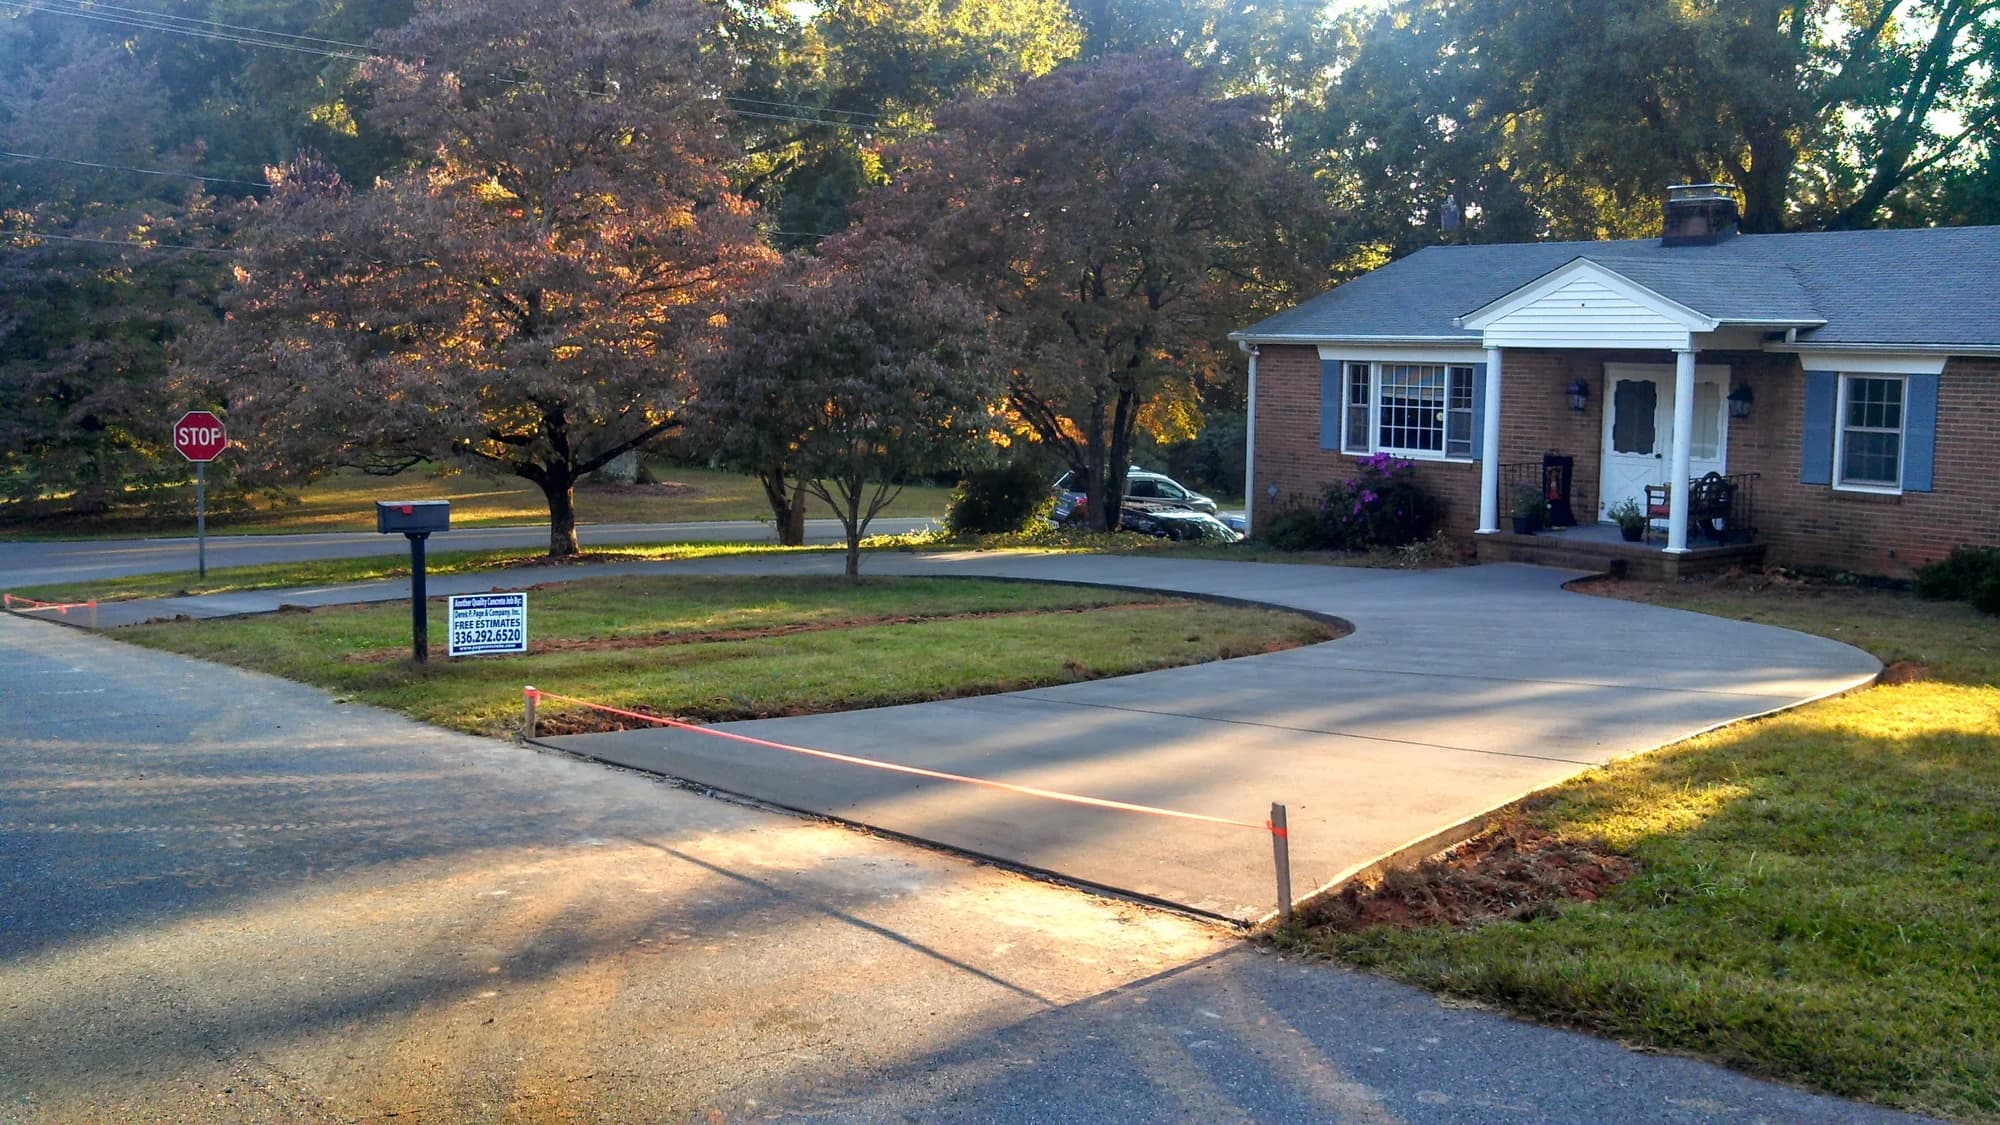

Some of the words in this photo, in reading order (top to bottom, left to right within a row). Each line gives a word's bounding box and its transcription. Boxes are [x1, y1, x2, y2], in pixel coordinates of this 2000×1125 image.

[178, 427, 221, 446] STOP
[454, 598, 472, 608] Another
[472, 598, 487, 608] Quality
[488, 598, 506, 606] Concrete
[506, 597, 514, 605] Job
[455, 610, 468, 618] Derek
[474, 610, 484, 619] Page
[455, 620, 474, 630] FREE
[476, 618, 520, 628] ESTIMATES
[455, 629, 520, 644] 336.292.6520
